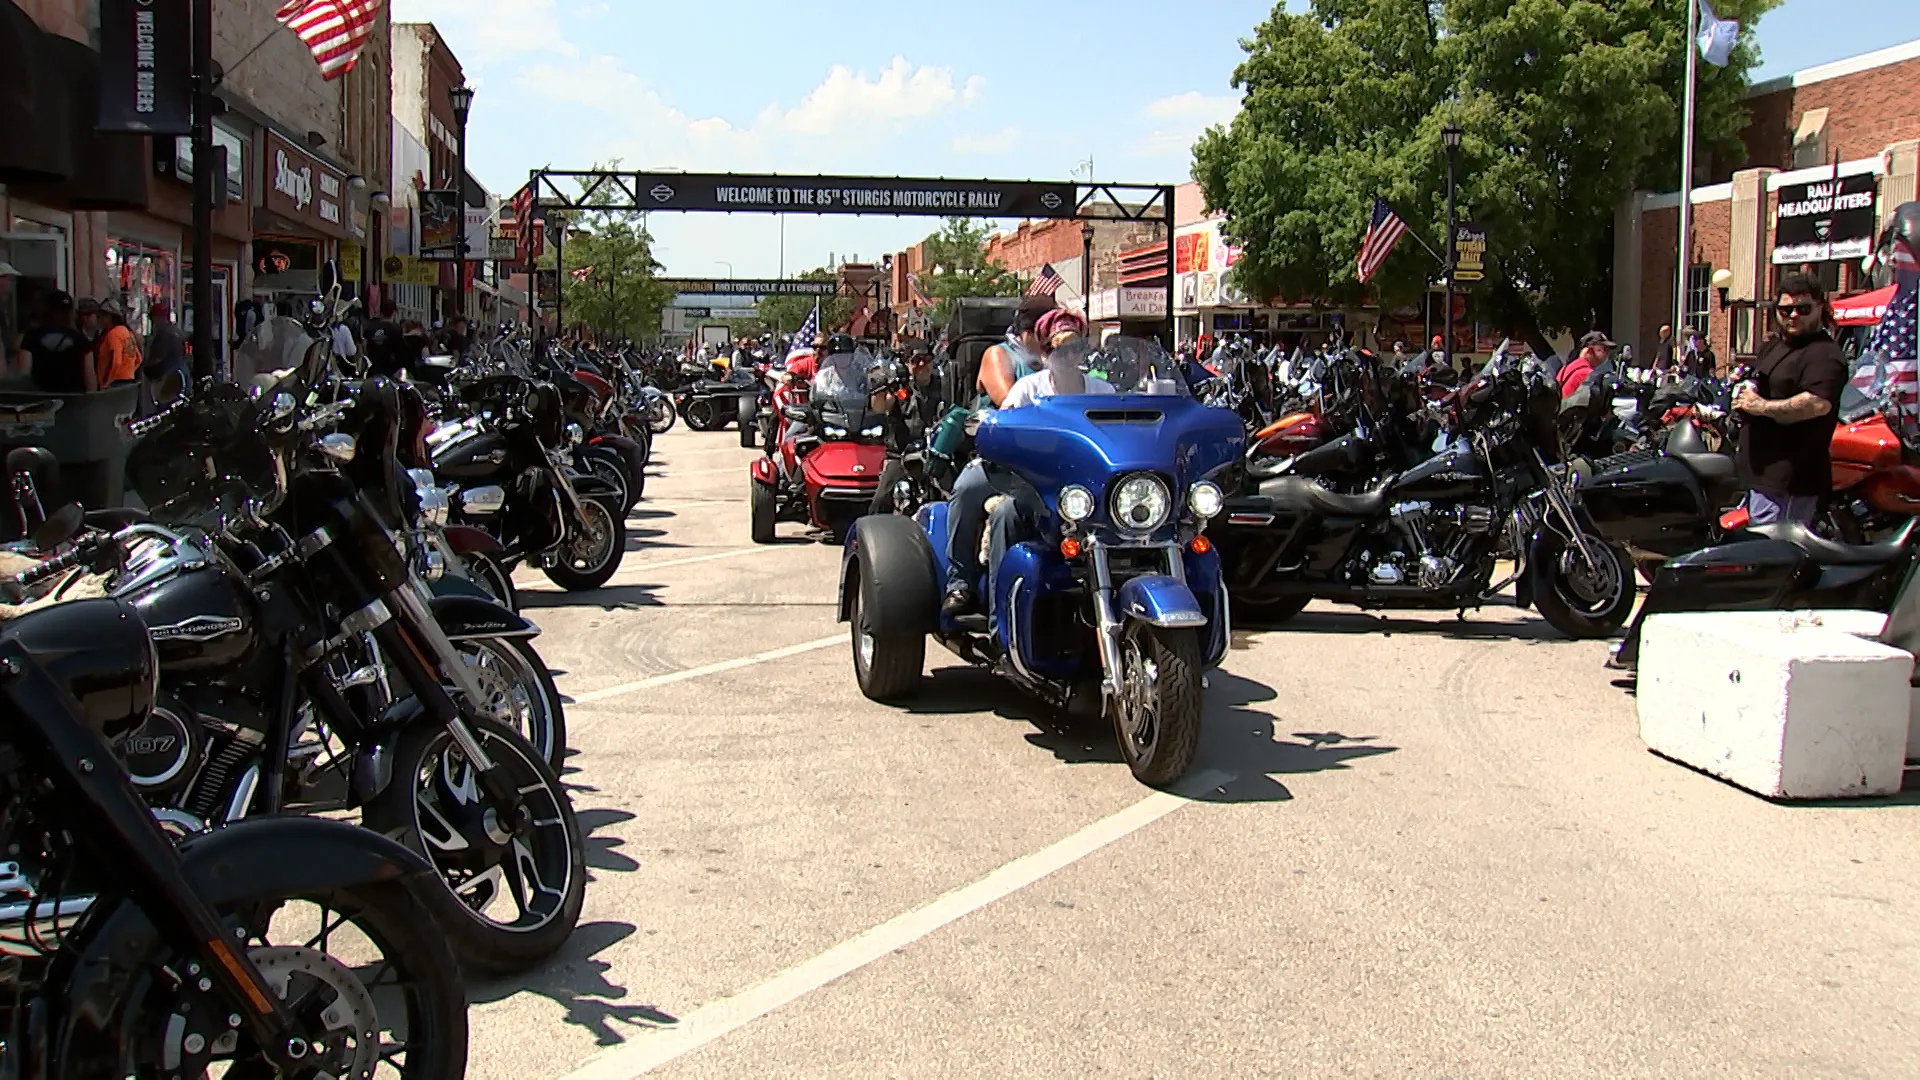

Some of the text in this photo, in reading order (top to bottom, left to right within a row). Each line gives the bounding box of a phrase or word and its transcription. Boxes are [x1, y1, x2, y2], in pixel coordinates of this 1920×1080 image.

[136, 11, 154, 112] WELCOME RIDERS
[716, 186, 774, 204] WELCOME
[775, 188, 791, 204] TO
[793, 188, 815, 205] THE
[842, 189, 891, 207] STURGIS
[893, 190, 966, 208] MOTORCYCLE
[968, 190, 1001, 208] RALLY
[1807, 181, 1844, 199] RALLY
[1778, 191, 1873, 218] HEADQUARTERS
[714, 282, 777, 292] MOTORCYCLE
[1126, 291, 1164, 302] Breakfa
[1131, 303, 1146, 312] All
[152, 622, 238, 636] ARLEY-DAVIDSON
